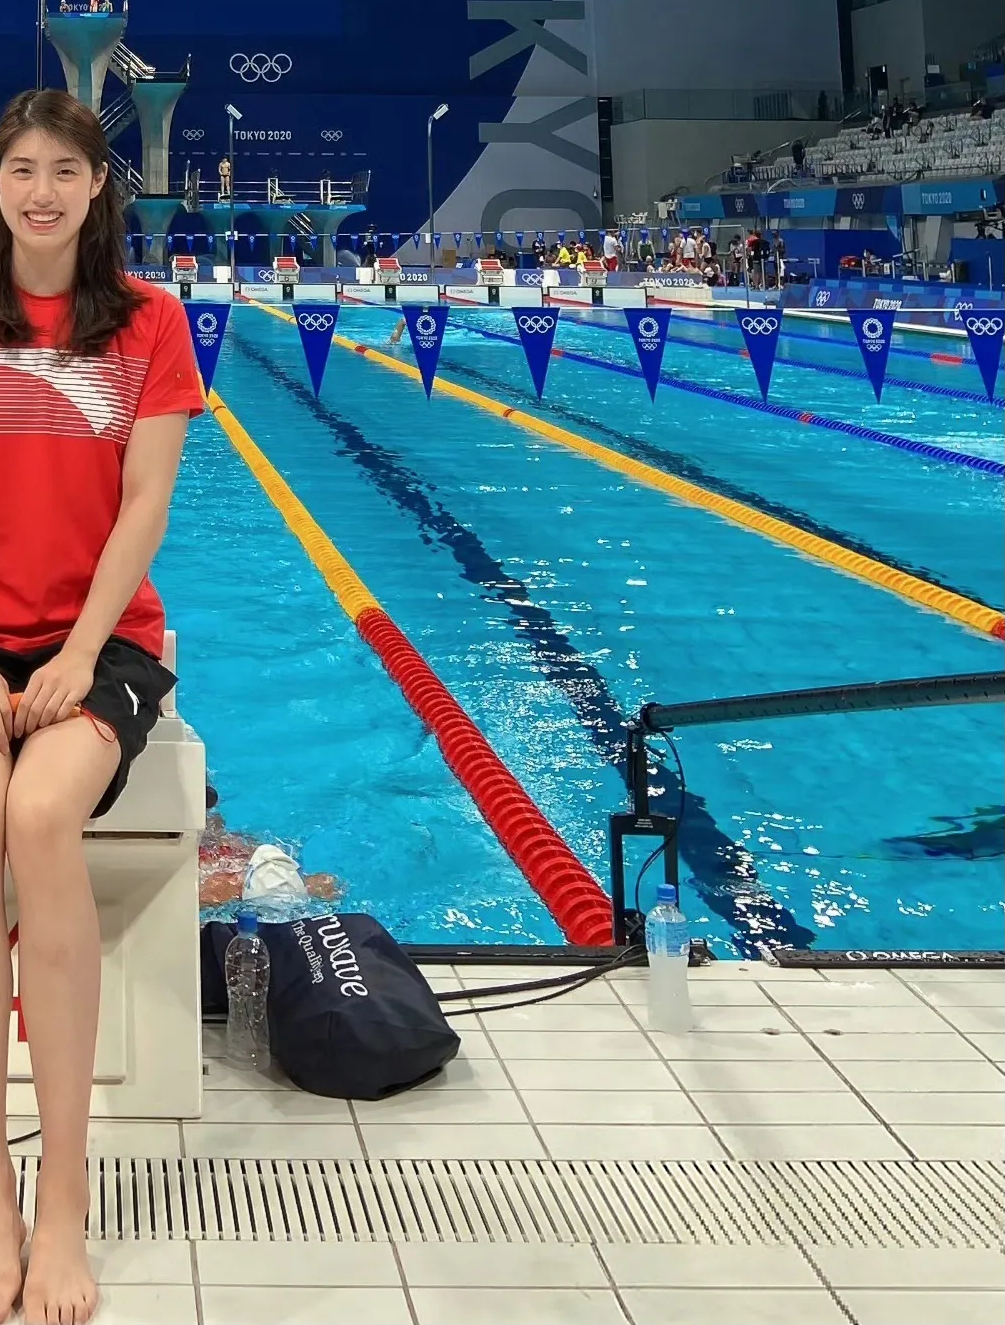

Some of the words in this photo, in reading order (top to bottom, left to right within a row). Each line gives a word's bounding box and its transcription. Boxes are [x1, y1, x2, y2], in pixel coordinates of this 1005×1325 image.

[68, 3, 89, 12] OKYO
[234, 130, 266, 140] TOKYO
[267, 130, 292, 140] 2020
[145, 271, 166, 280] 2020
[406, 273, 428, 282] 2020
[292, 920, 306, 937] The
